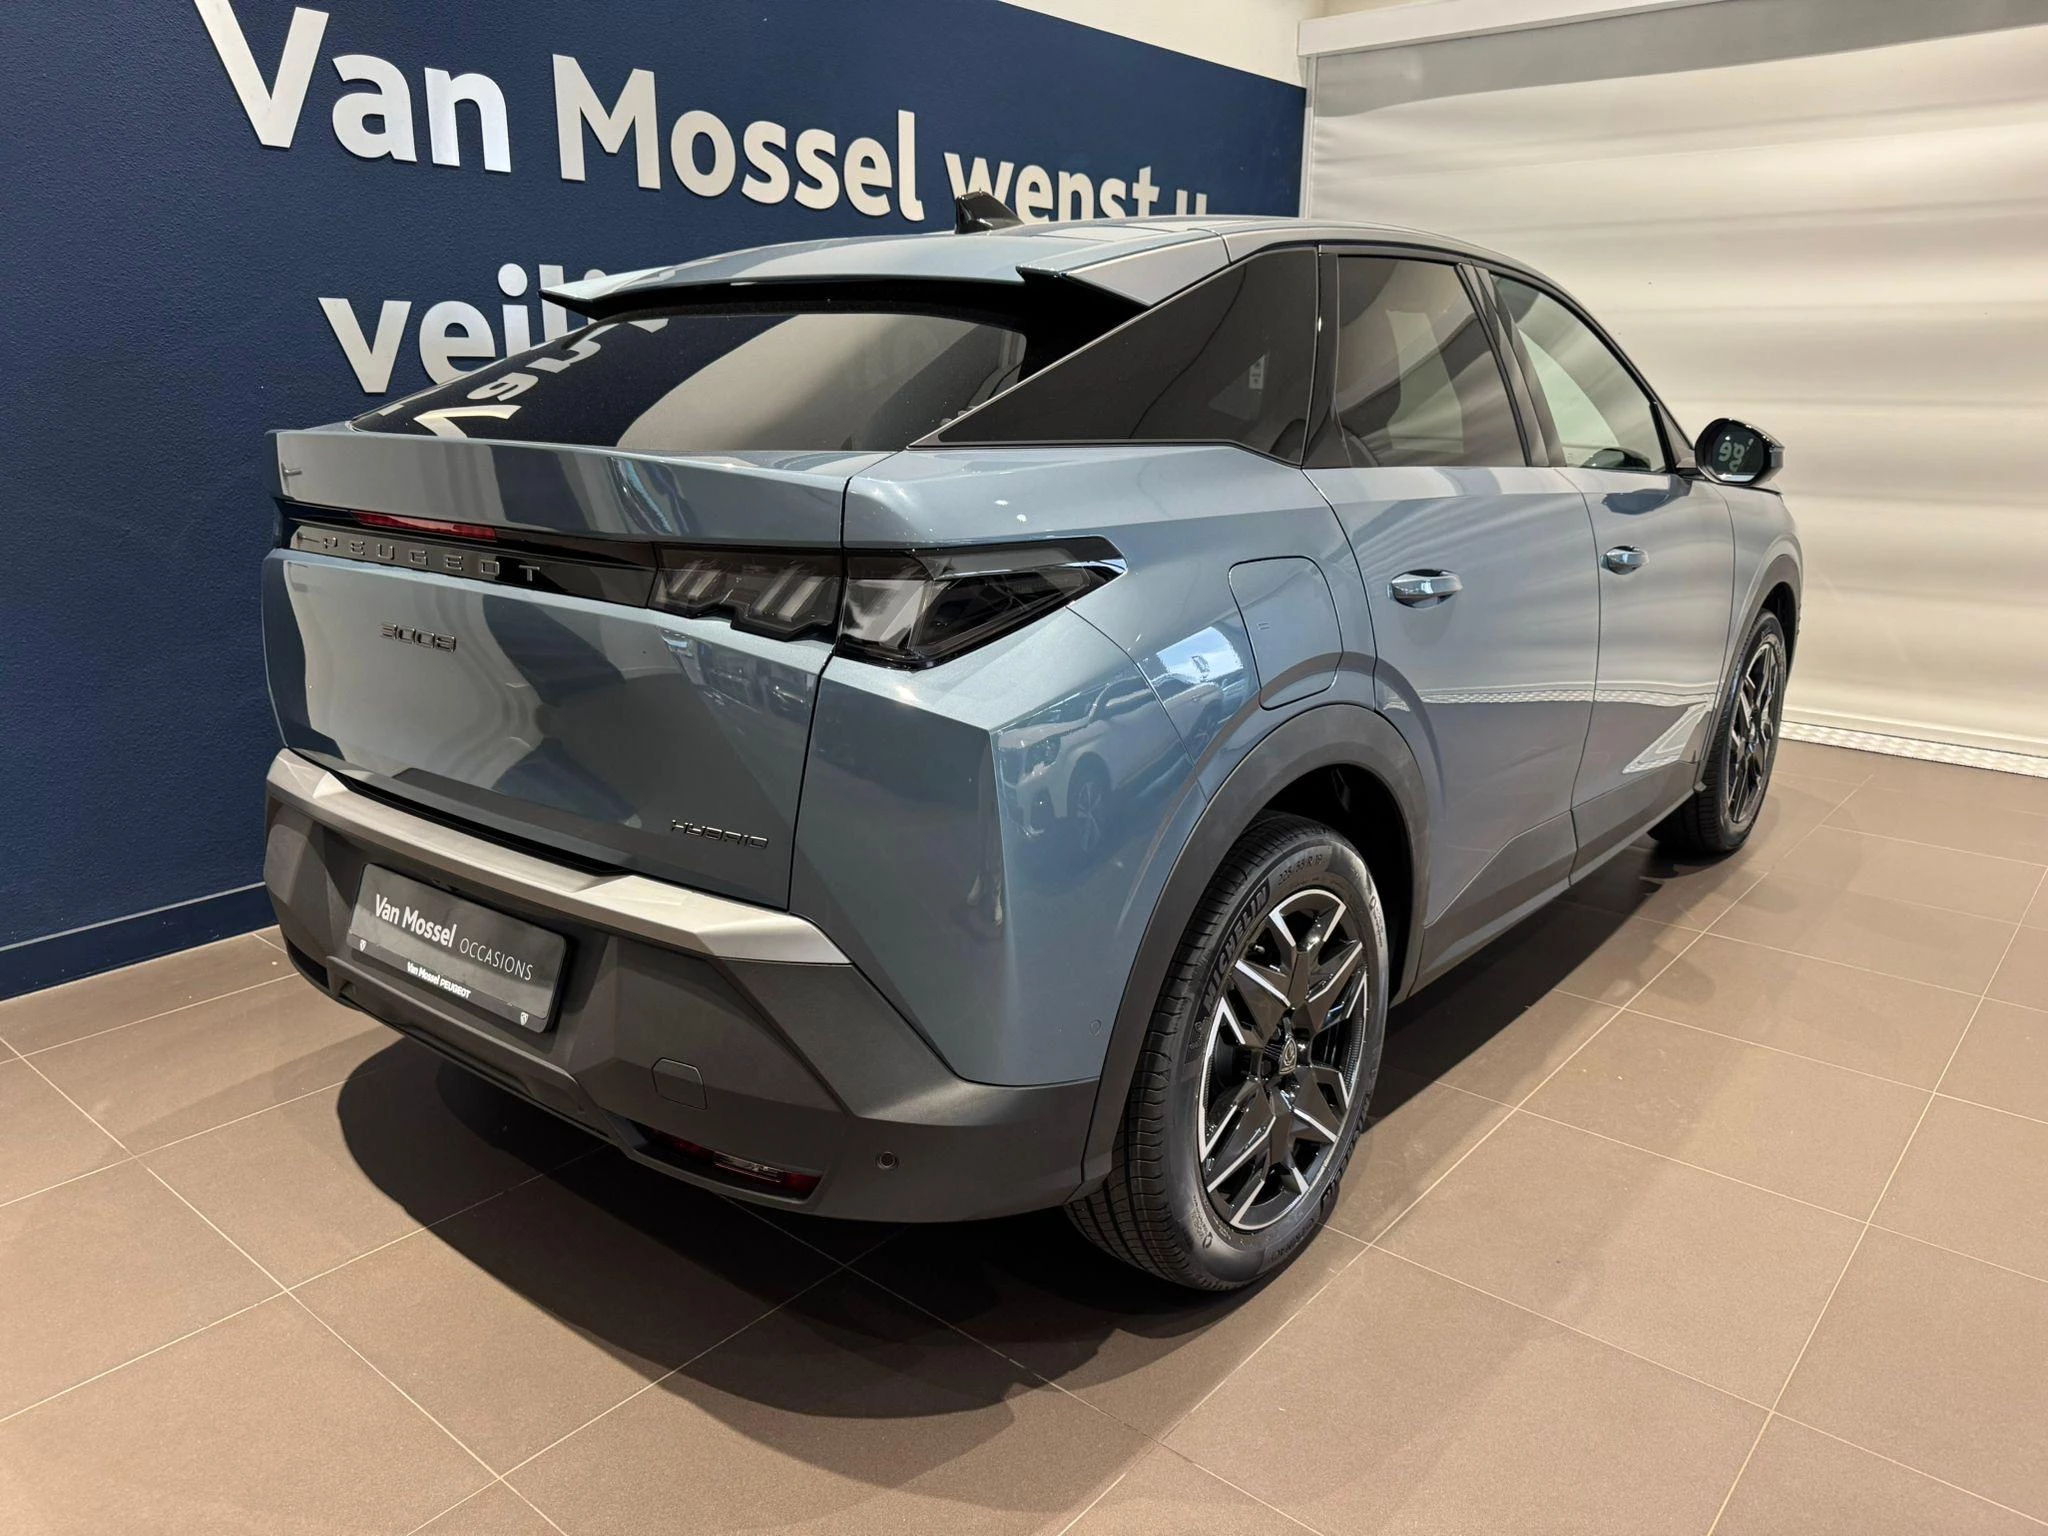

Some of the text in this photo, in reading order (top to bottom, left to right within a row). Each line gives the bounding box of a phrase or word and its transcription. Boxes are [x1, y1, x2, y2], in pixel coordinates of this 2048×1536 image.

[194, 0, 512, 174] Van
[552, 53, 925, 221] Mossel
[944, 152, 1160, 224] wenst
[319, 263, 606, 393] veil
[323, 537, 540, 582] PEUGEOT
[671, 819, 769, 849] HYBRID
[375, 894, 533, 981] Van Mossel OCCASIONS
[407, 961, 472, 999] Van Mossel PEUGEOT
[1202, 886, 1269, 1014] MICHELIN
